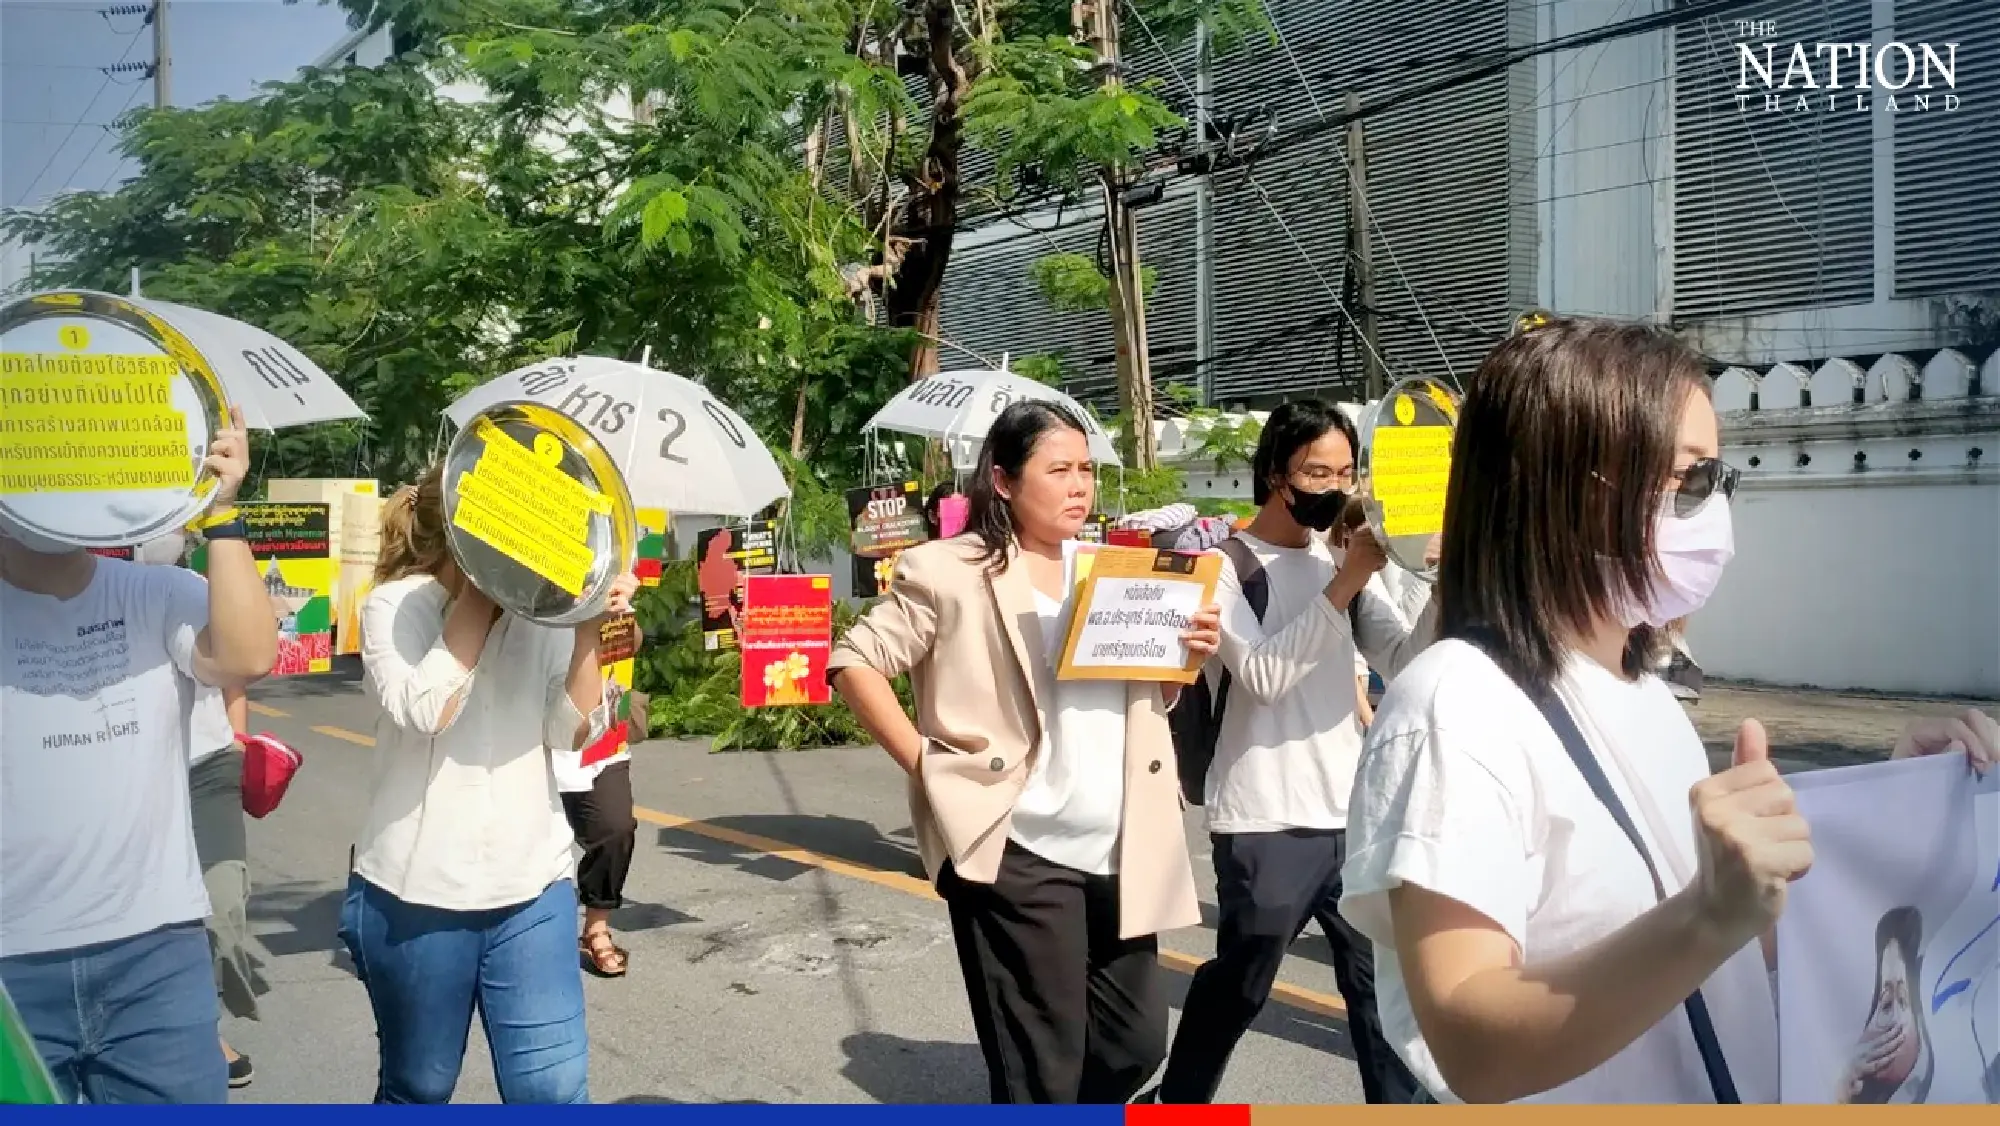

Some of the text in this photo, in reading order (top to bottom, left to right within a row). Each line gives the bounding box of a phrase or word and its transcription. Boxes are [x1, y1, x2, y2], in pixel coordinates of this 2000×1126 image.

[657, 408, 689, 465] 2
[867, 496, 907, 519] STOP
[42, 732, 93, 749] HUMAN
